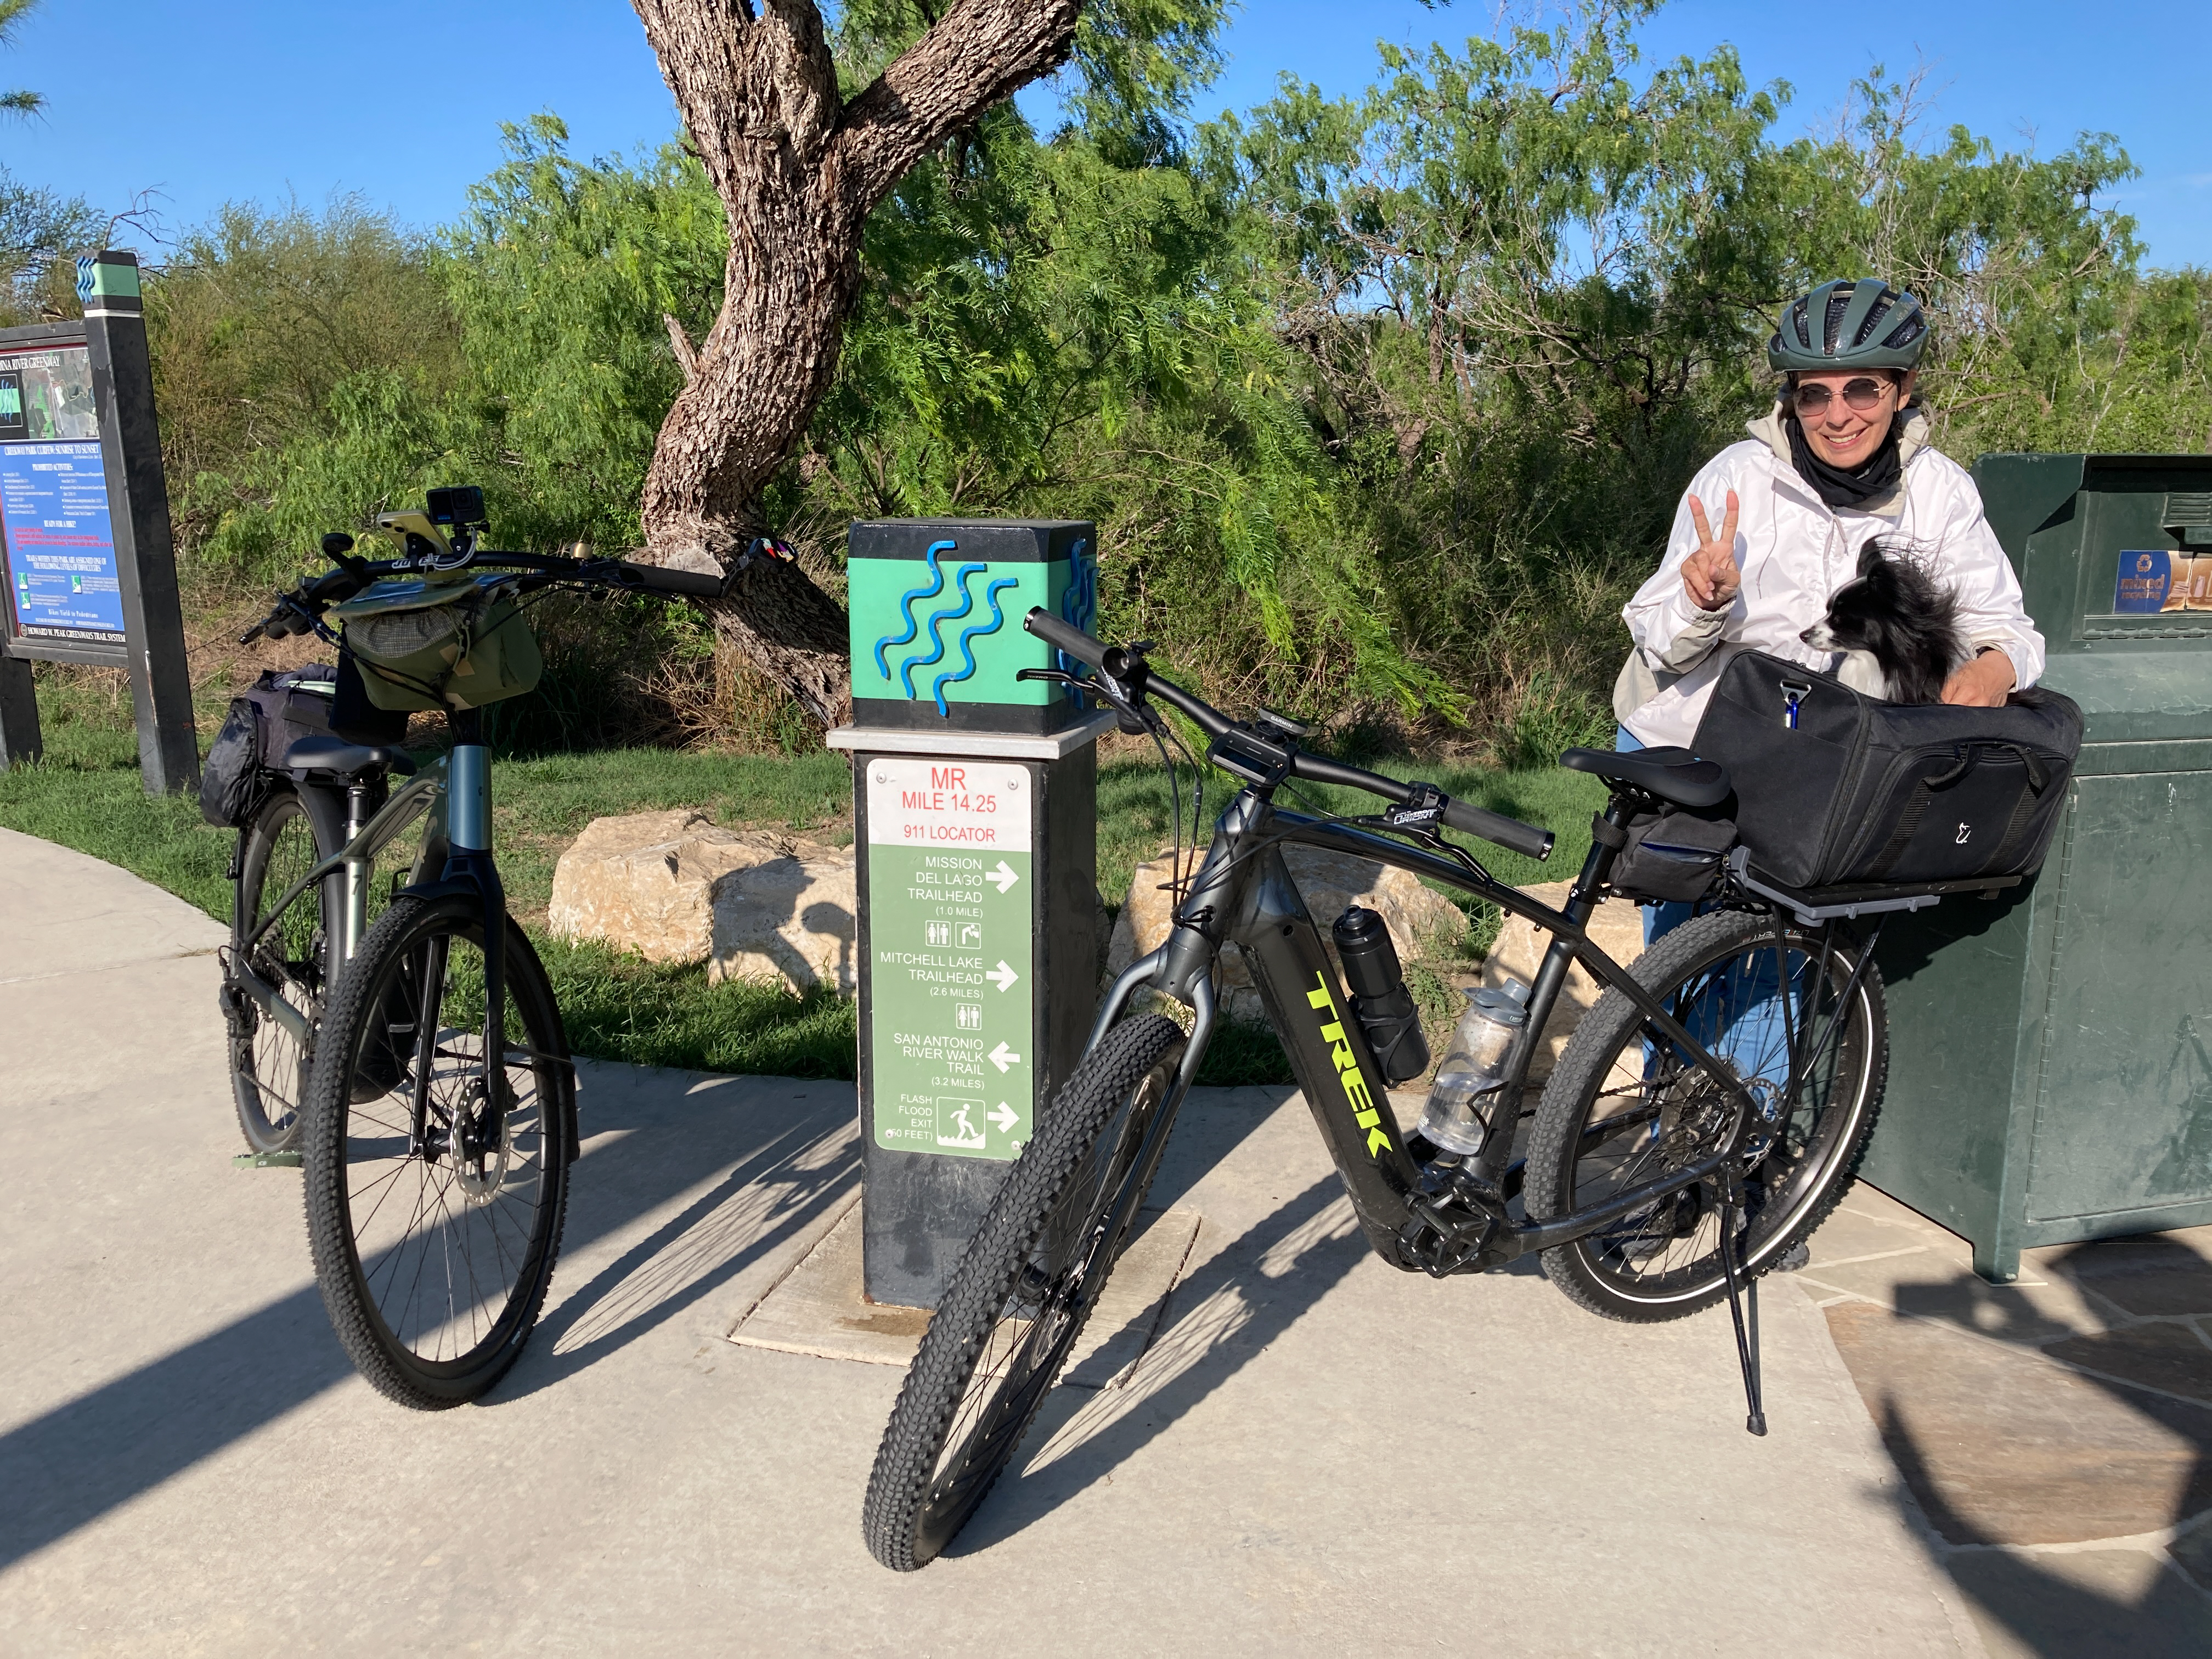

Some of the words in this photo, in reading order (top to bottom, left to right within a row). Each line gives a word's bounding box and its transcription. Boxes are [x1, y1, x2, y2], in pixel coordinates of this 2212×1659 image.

[12, 358, 29, 370] RIVER
[29, 356, 60, 368] GREENWAY
[55, 445, 75, 454] SUNRISE
[74, 445, 81, 454] TO
[81, 444, 99, 454] SUNSET
[2120, 574, 2165, 589] mixed
[27, 627, 48, 635] HOWARD
[54, 629, 66, 637] PEAK
[66, 630, 93, 640] GREENWAYS
[93, 632, 108, 641] TRAIL
[107, 633, 126, 642] SYSTEM
[1271, 715, 1293, 729] GARMIN
[932, 767, 966, 791] MR
[902, 791, 944, 811] MILE
[951, 794, 996, 813] 14.25
[904, 825, 925, 839] 911
[930, 826, 996, 842] LOCATOR
[926, 856, 983, 870] MISSION
[916, 872, 941, 884] DEL
[945, 873, 983, 887] LAGO
[907, 888, 983, 903] TRAILHEAD
[935, 906, 953, 917] (1.0
[956, 907, 983, 919] MILE)
[1753, 929, 1791, 940] EPERT
[880, 951, 946, 967] MITCHELL
[949, 956, 983, 969] LAKE
[908, 969, 983, 985] TRAILHEAD
[930, 986, 947, 997] (2.6
[950, 988, 984, 1000] MILES)
[894, 1033, 921, 1045] SAN
[923, 1035, 984, 1050] ANTONIO
[903, 1047, 943, 1060] RIVER
[947, 1049, 984, 1063] WALK
[946, 1062, 984, 1075] TRAIL
[1306, 970, 1393, 1159] TREK
[932, 1076, 949, 1087] (3.2
[951, 1078, 985, 1091] MILES)
[901, 1093, 932, 1104] FLASH
[899, 1106, 933, 1116] FLOOD
[911, 1118, 933, 1128] EXIT
[905, 1130, 933, 1142] FEET)
